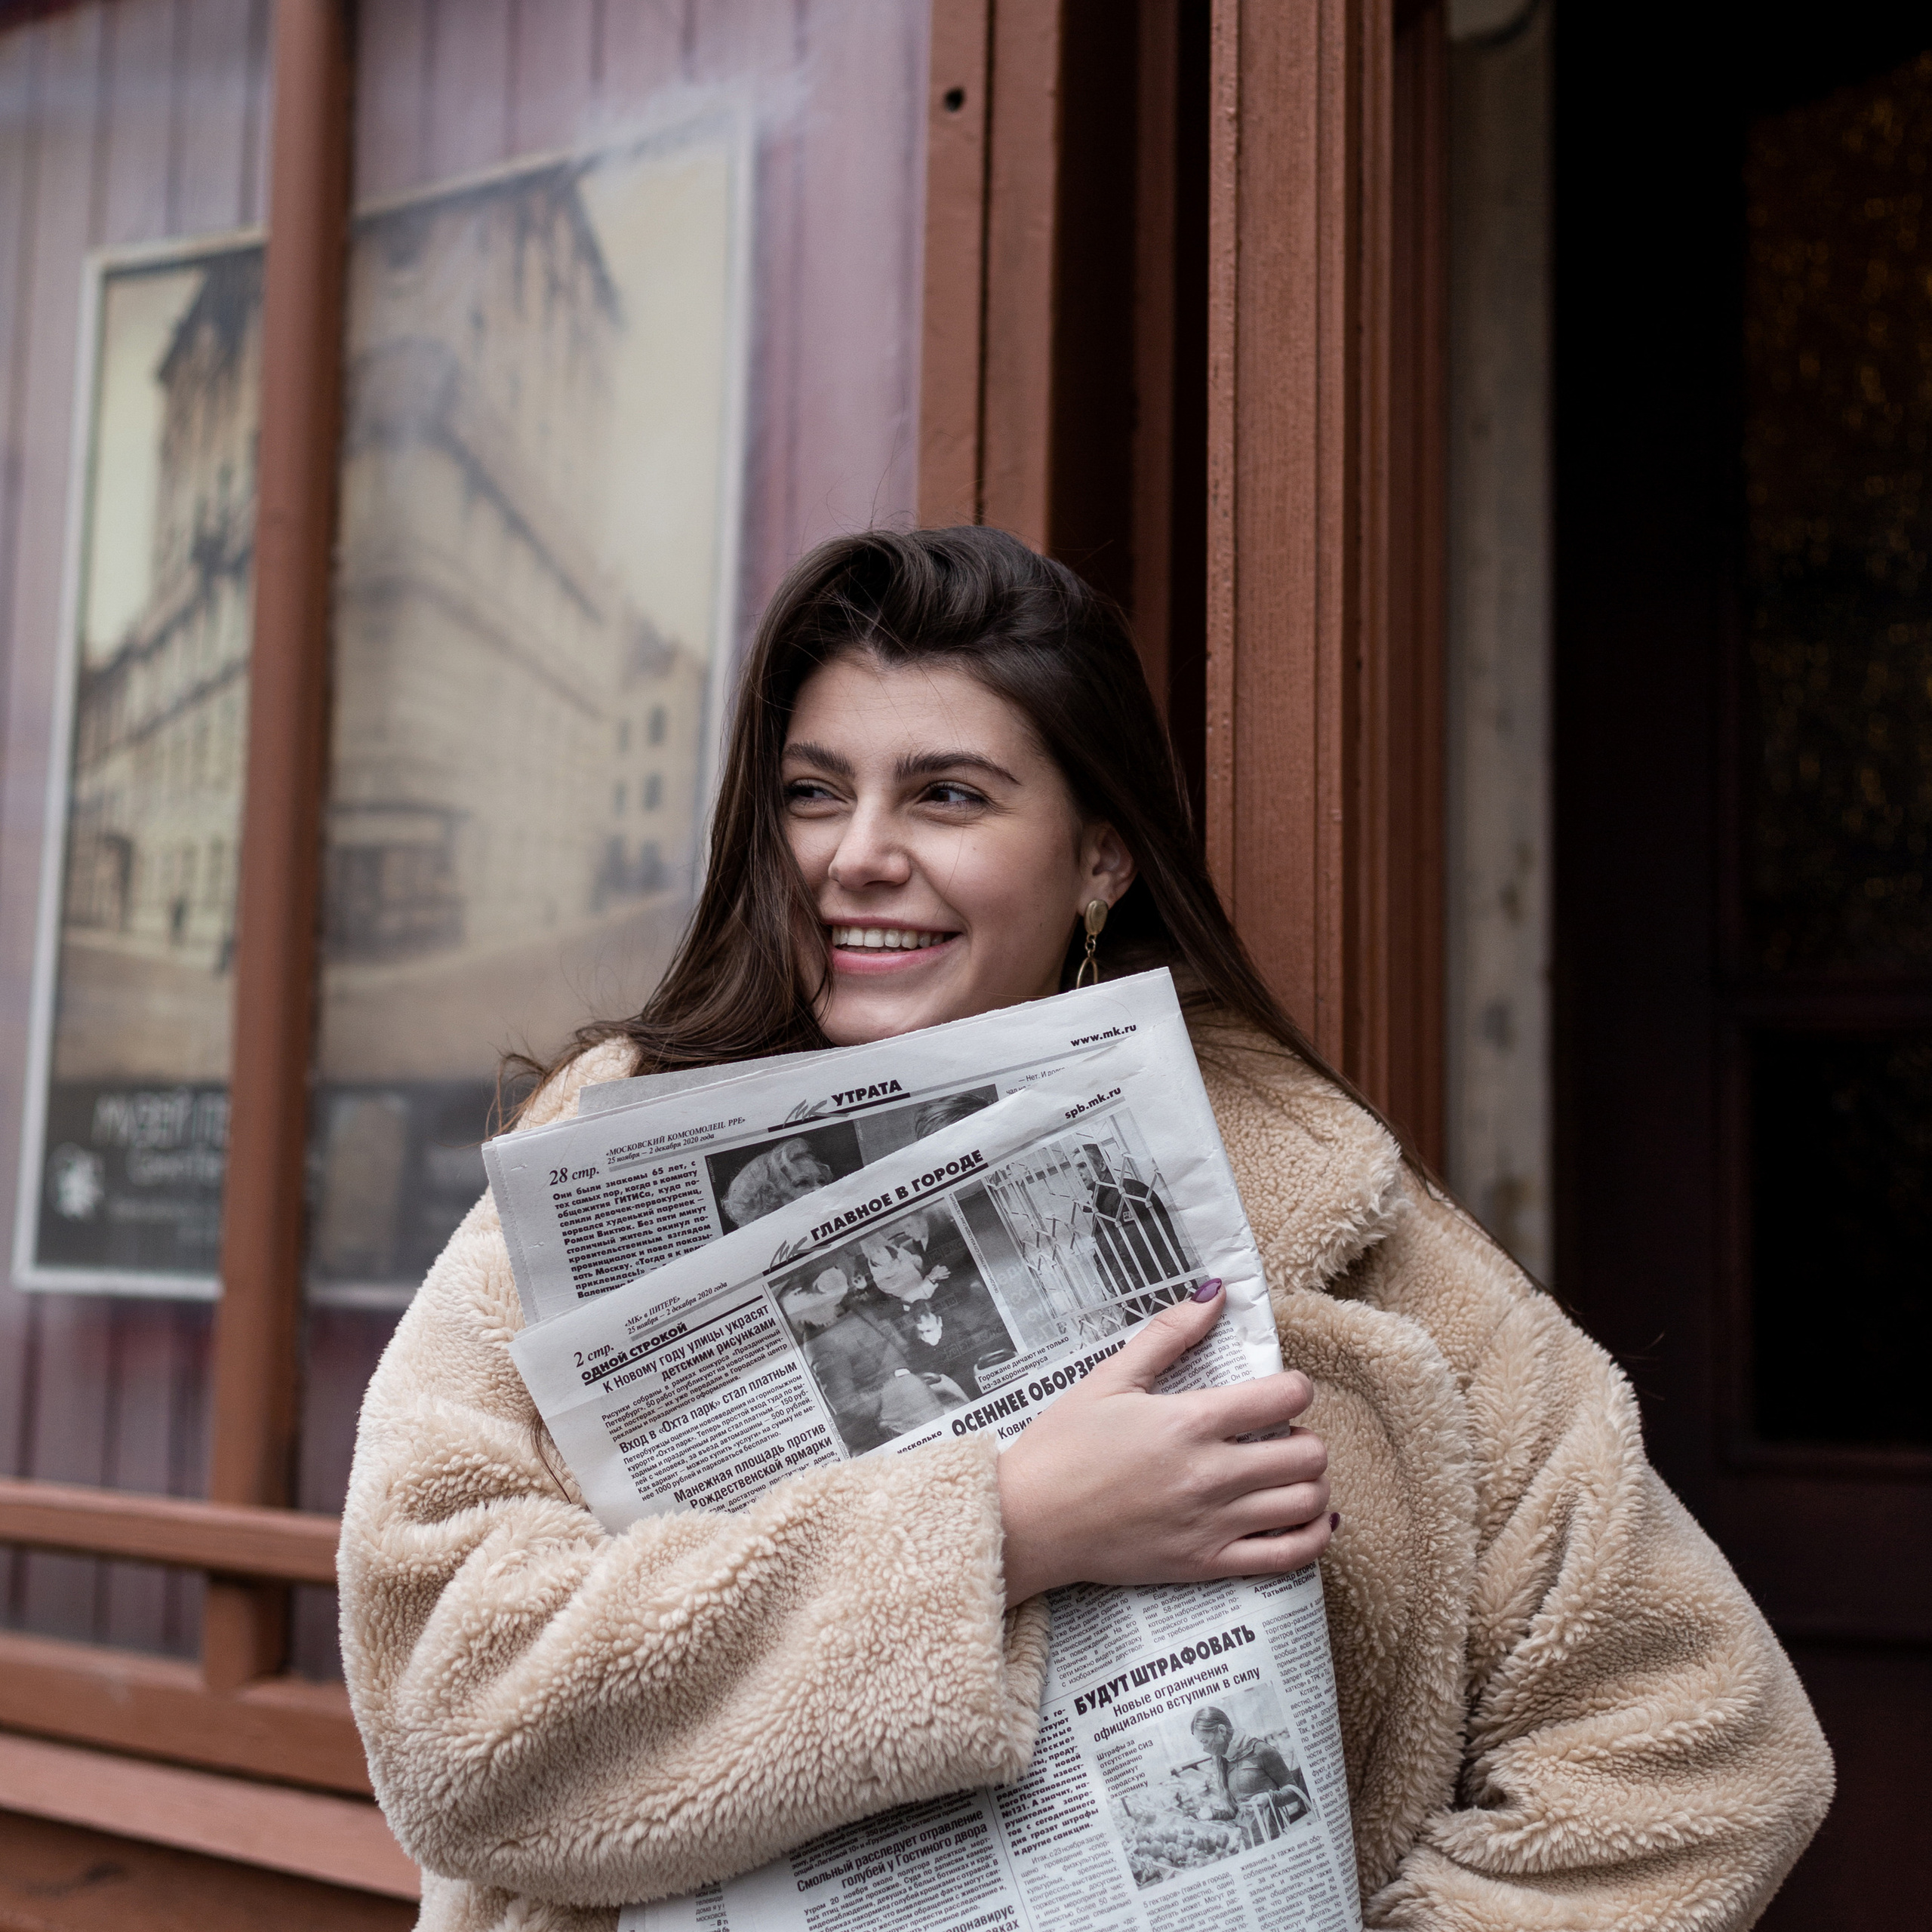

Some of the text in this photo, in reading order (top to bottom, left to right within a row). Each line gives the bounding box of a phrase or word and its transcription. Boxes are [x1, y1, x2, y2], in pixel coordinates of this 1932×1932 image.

[1069, 1024, 1137, 1047] www.mk.ru
[830, 1078, 903, 1106] УТРАТА
[1064, 1087, 1121, 1119] spb.mk.ru
[605, 1135, 665, 1156] «МОСКОВСКИЙ
[666, 1121, 726, 1142] КОМСОМОЛЕЦ.
[607, 1133, 715, 1164] 25 ноября 2 декабря 2020 года
[549, 1166, 599, 1186] 28 стр.
[552, 1191, 572, 1201] Они
[575, 1184, 601, 1195] были
[605, 1172, 648, 1188] знакомы
[651, 1166, 664, 1176] 65
[668, 1163, 687, 1172] лет,
[554, 1201, 570, 1210] тех
[571, 1193, 601, 1206] самых
[602, 1189, 623, 1198] пор,
[624, 1181, 651, 1192] когда
[659, 1169, 697, 1184] комнату
[810, 1192, 893, 1241] ГЛАВНОЕ
[894, 1185, 909, 1200] В
[910, 1149, 983, 1192] ГОРОДЕ
[561, 1198, 695, 1237] ворвался худенький паренек
[563, 1205, 706, 1245] Роман Виктюк. Без пяти минут
[627, 1324, 635, 1335] 25
[635, 1315, 659, 1331] ноября
[671, 1297, 697, 1313] декабря
[697, 1287, 712, 1300] 2020
[713, 1281, 728, 1292] года
[648, 1295, 681, 1315] ПИТЕРЕ»
[573, 1343, 614, 1367] 2 стр.
[580, 1321, 688, 1380] ОДНОЙ СТРОКОЙ
[601, 1304, 769, 1393] К Новому году улицы украсят
[660, 1317, 777, 1382] детскими рисунками
[977, 1363, 1011, 1383] Горожане
[1011, 1351, 1036, 1368] дичают
[1045, 1336, 1069, 1350] только
[601, 1404, 631, 1421] Рисунки
[632, 1388, 663, 1406] собраны
[671, 1371, 697, 1389] рамках
[697, 1354, 730, 1374] конкурса
[731, 1328, 781, 1356] «Праздничный
[981, 1355, 1048, 1391] из-за коронавируса
[618, 1361, 798, 1454] Вход в «Охта парк» стал платным
[952, 1389, 1029, 1436] ОСЕННЕЕ
[672, 1468, 734, 1503] Манежная
[734, 1444, 785, 1474] площадь
[786, 1423, 826, 1449] против
[689, 1460, 783, 1509] Рождественской
[784, 1435, 832, 1466] ярмарки
[1073, 1624, 1256, 1716] БУДУТ ШТРАФОВАТЬ
[1094, 1666, 1260, 1742] официально вступили в силу
[1112, 1663, 1229, 1717] Новые ограничения
[1096, 1739, 1135, 1761] Штрафы за
[1099, 1739, 1153, 1769] отсутствие СИЗ
[1102, 1754, 1143, 1777] однозначно
[995, 1763, 1084, 1801] редакцией извест-
[998, 1771, 1087, 1810] ного Постановления
[1104, 1764, 1138, 1784] поднимут
[1107, 1771, 1146, 1792] городскую
[1109, 1780, 1148, 1799] экономику
[1001, 1781, 1090, 1819] №121. А значит, на-
[1004, 1790, 1092, 1829] рушителям запре-
[1007, 1827, 1022, 1837] тов
[1035, 1798, 1096, 1826] сегодняшнего
[1011, 1807, 1099, 1848] дня грозят штрафы
[1021, 1837, 1051, 1855] другие
[1053, 1822, 1093, 1841] санкции.
[796, 1810, 983, 1892] Смольный расследует отравление
[841, 1823, 988, 1889] голубей у Гостиного двора
[803, 1837, 991, 1916] Утром 20 ноября около полутора десятков мерт-
